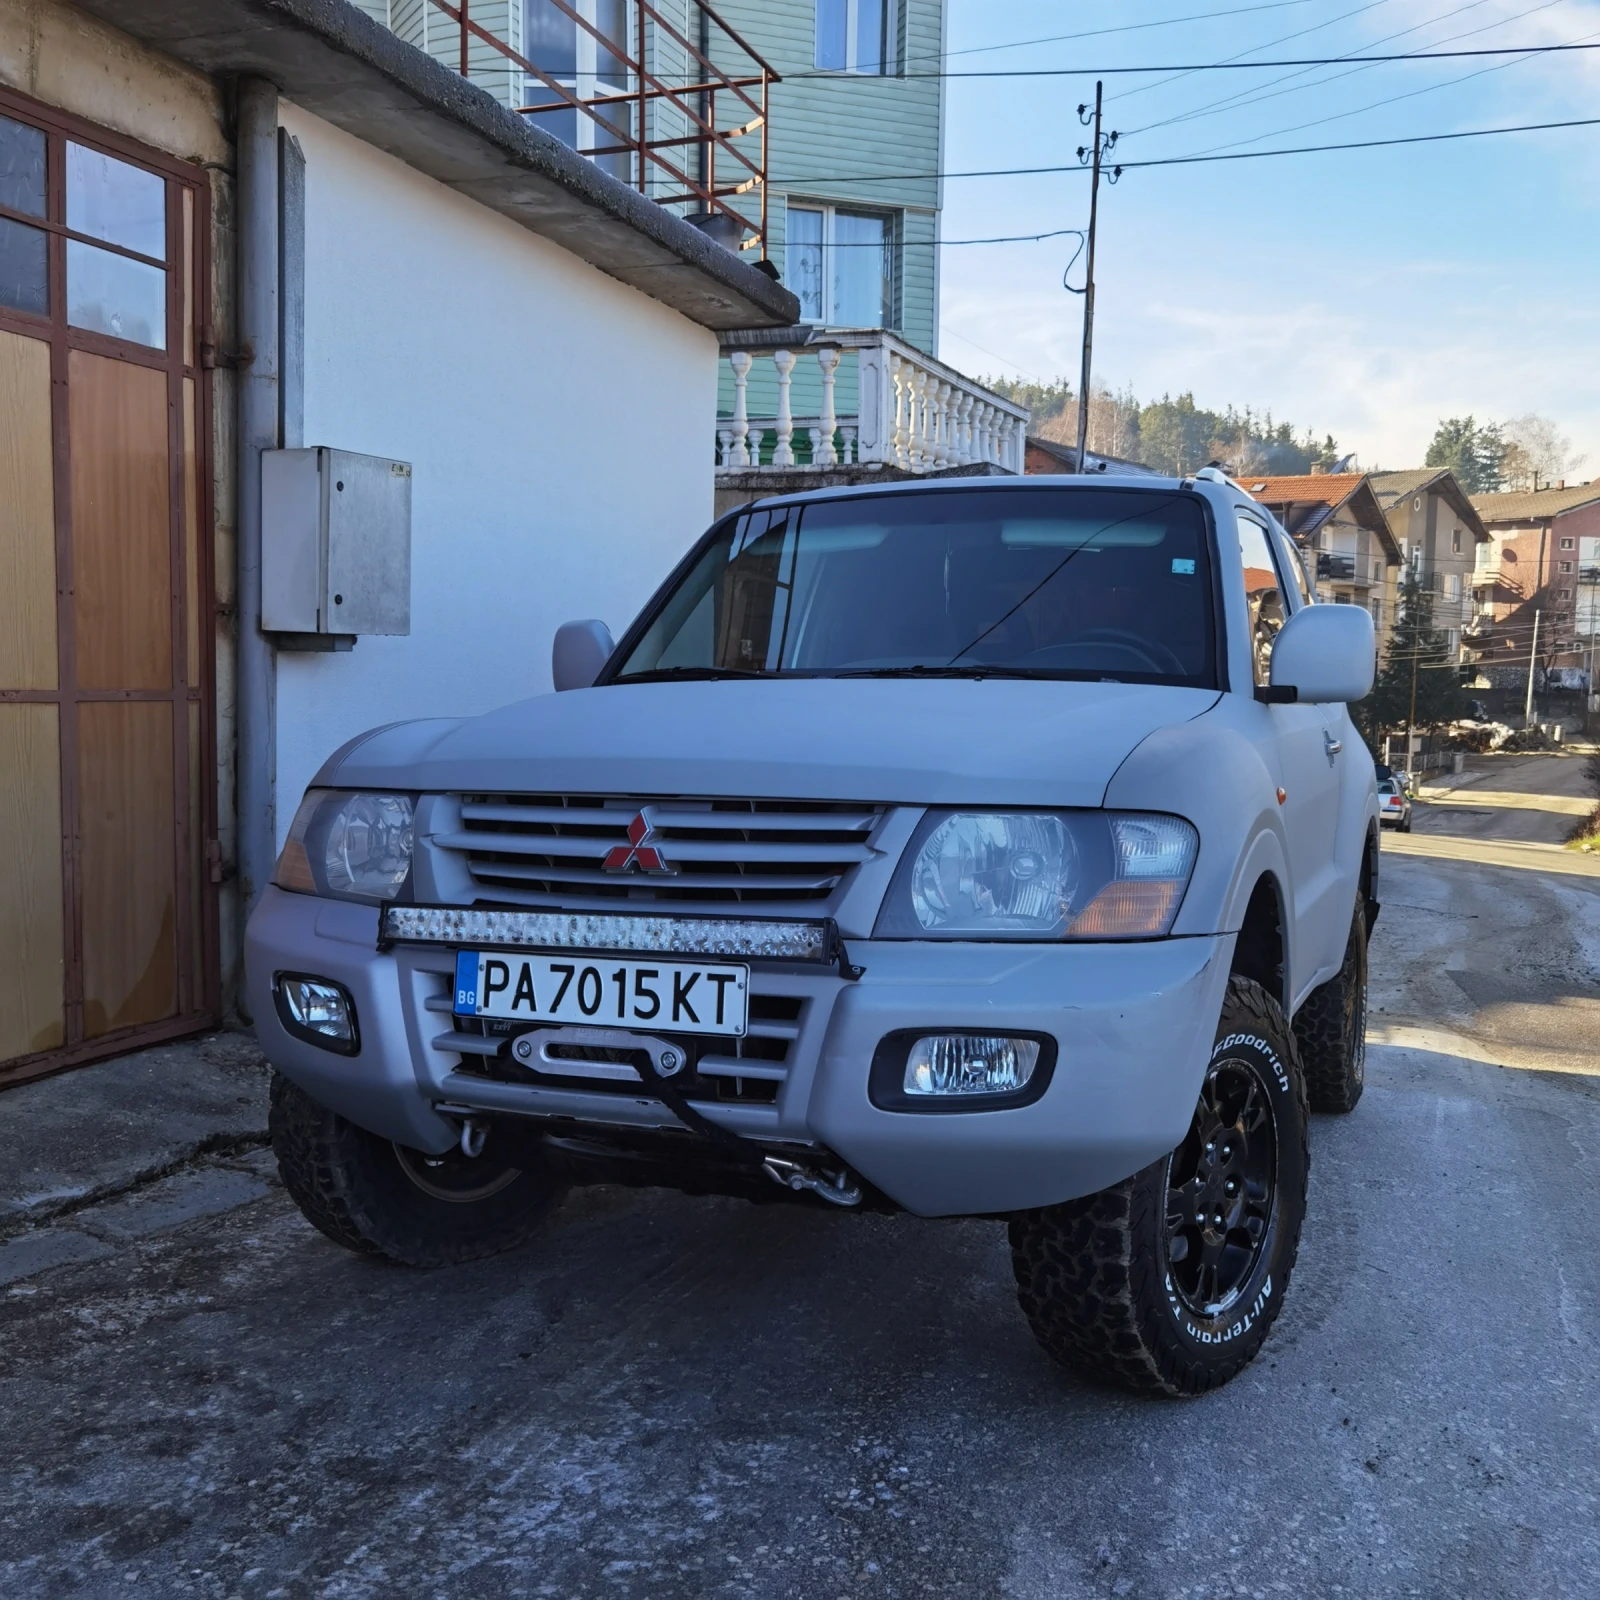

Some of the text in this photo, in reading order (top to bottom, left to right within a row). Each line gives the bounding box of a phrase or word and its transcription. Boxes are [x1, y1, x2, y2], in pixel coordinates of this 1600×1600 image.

[458, 989, 475, 1005] BG
[1212, 1033, 1289, 1092] FGoodrich
[1186, 1274, 1272, 1344] All-Terrain
